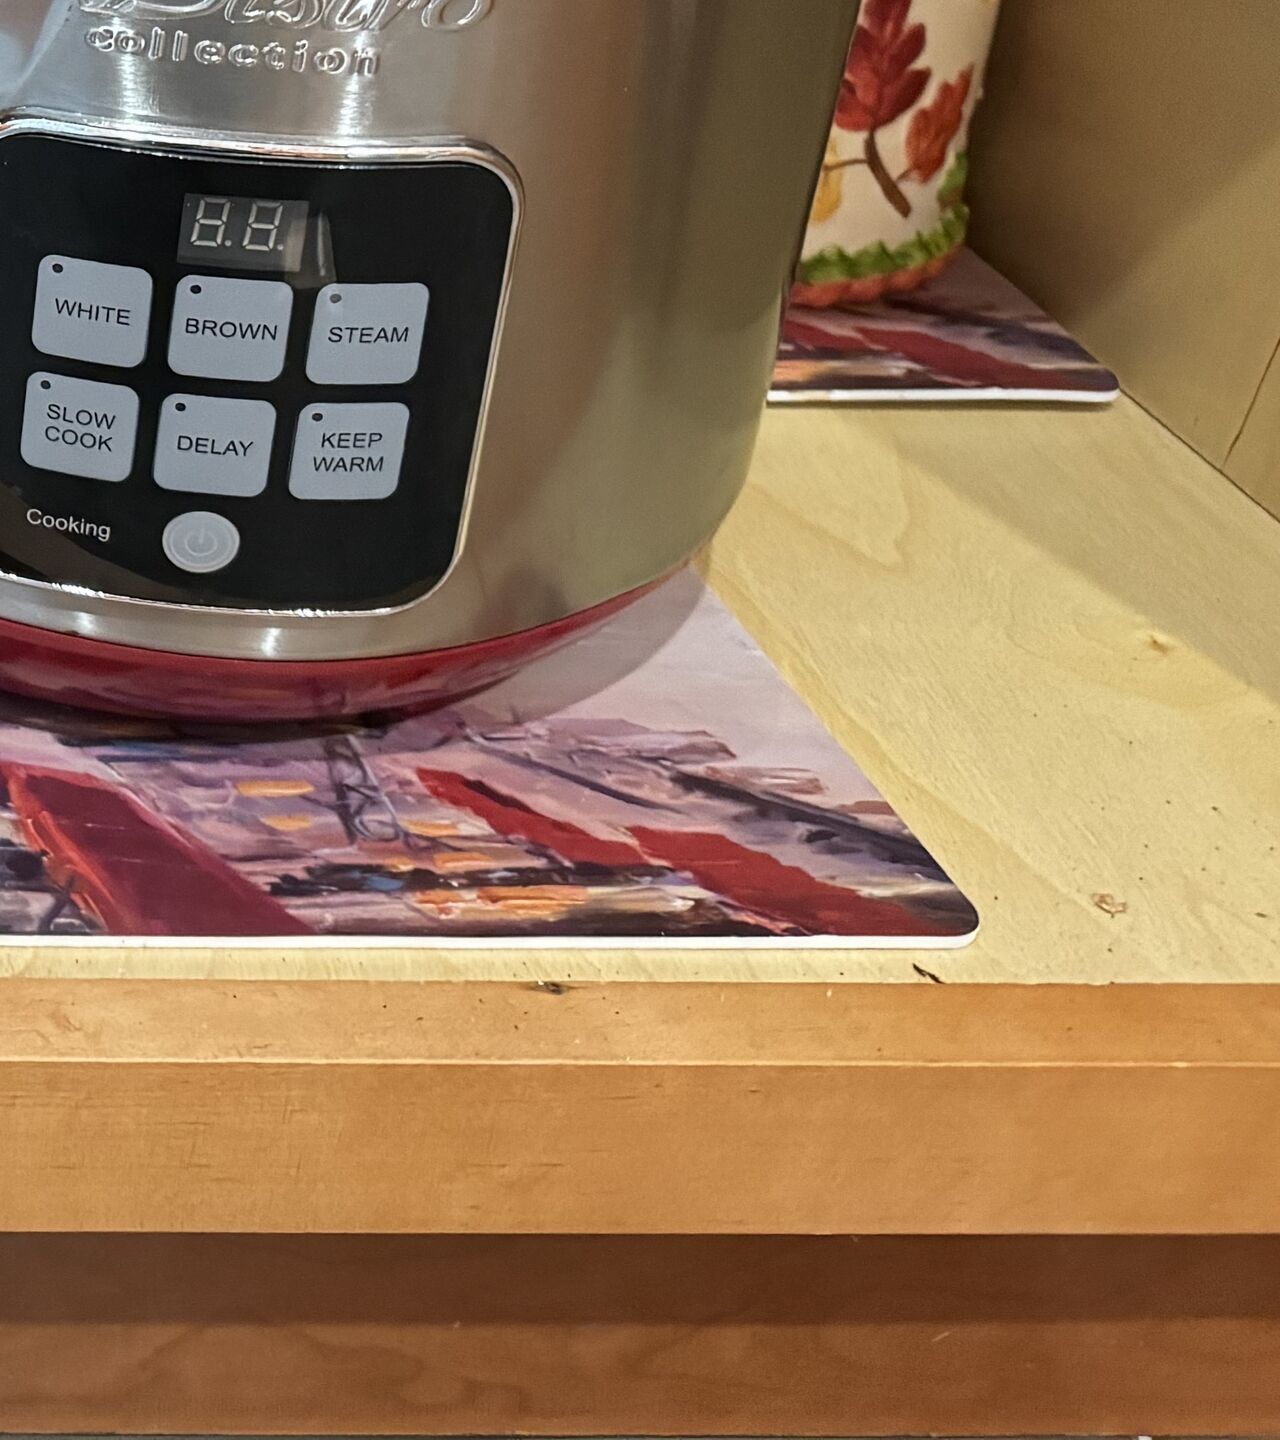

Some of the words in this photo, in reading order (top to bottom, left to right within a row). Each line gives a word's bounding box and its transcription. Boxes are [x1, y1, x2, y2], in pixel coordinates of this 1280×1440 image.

[85, 25, 382, 77] collection
[53, 297, 132, 327] WHITE
[184, 317, 279, 342] BROWN
[327, 325, 410, 345] STEAM
[46, 403, 117, 431] SLOW
[44, 424, 114, 453] COOK
[177, 434, 255, 458] DELAY
[320, 431, 384, 450] KEEP
[312, 455, 385, 474] WARM
[26, 508, 112, 541] Cooking
